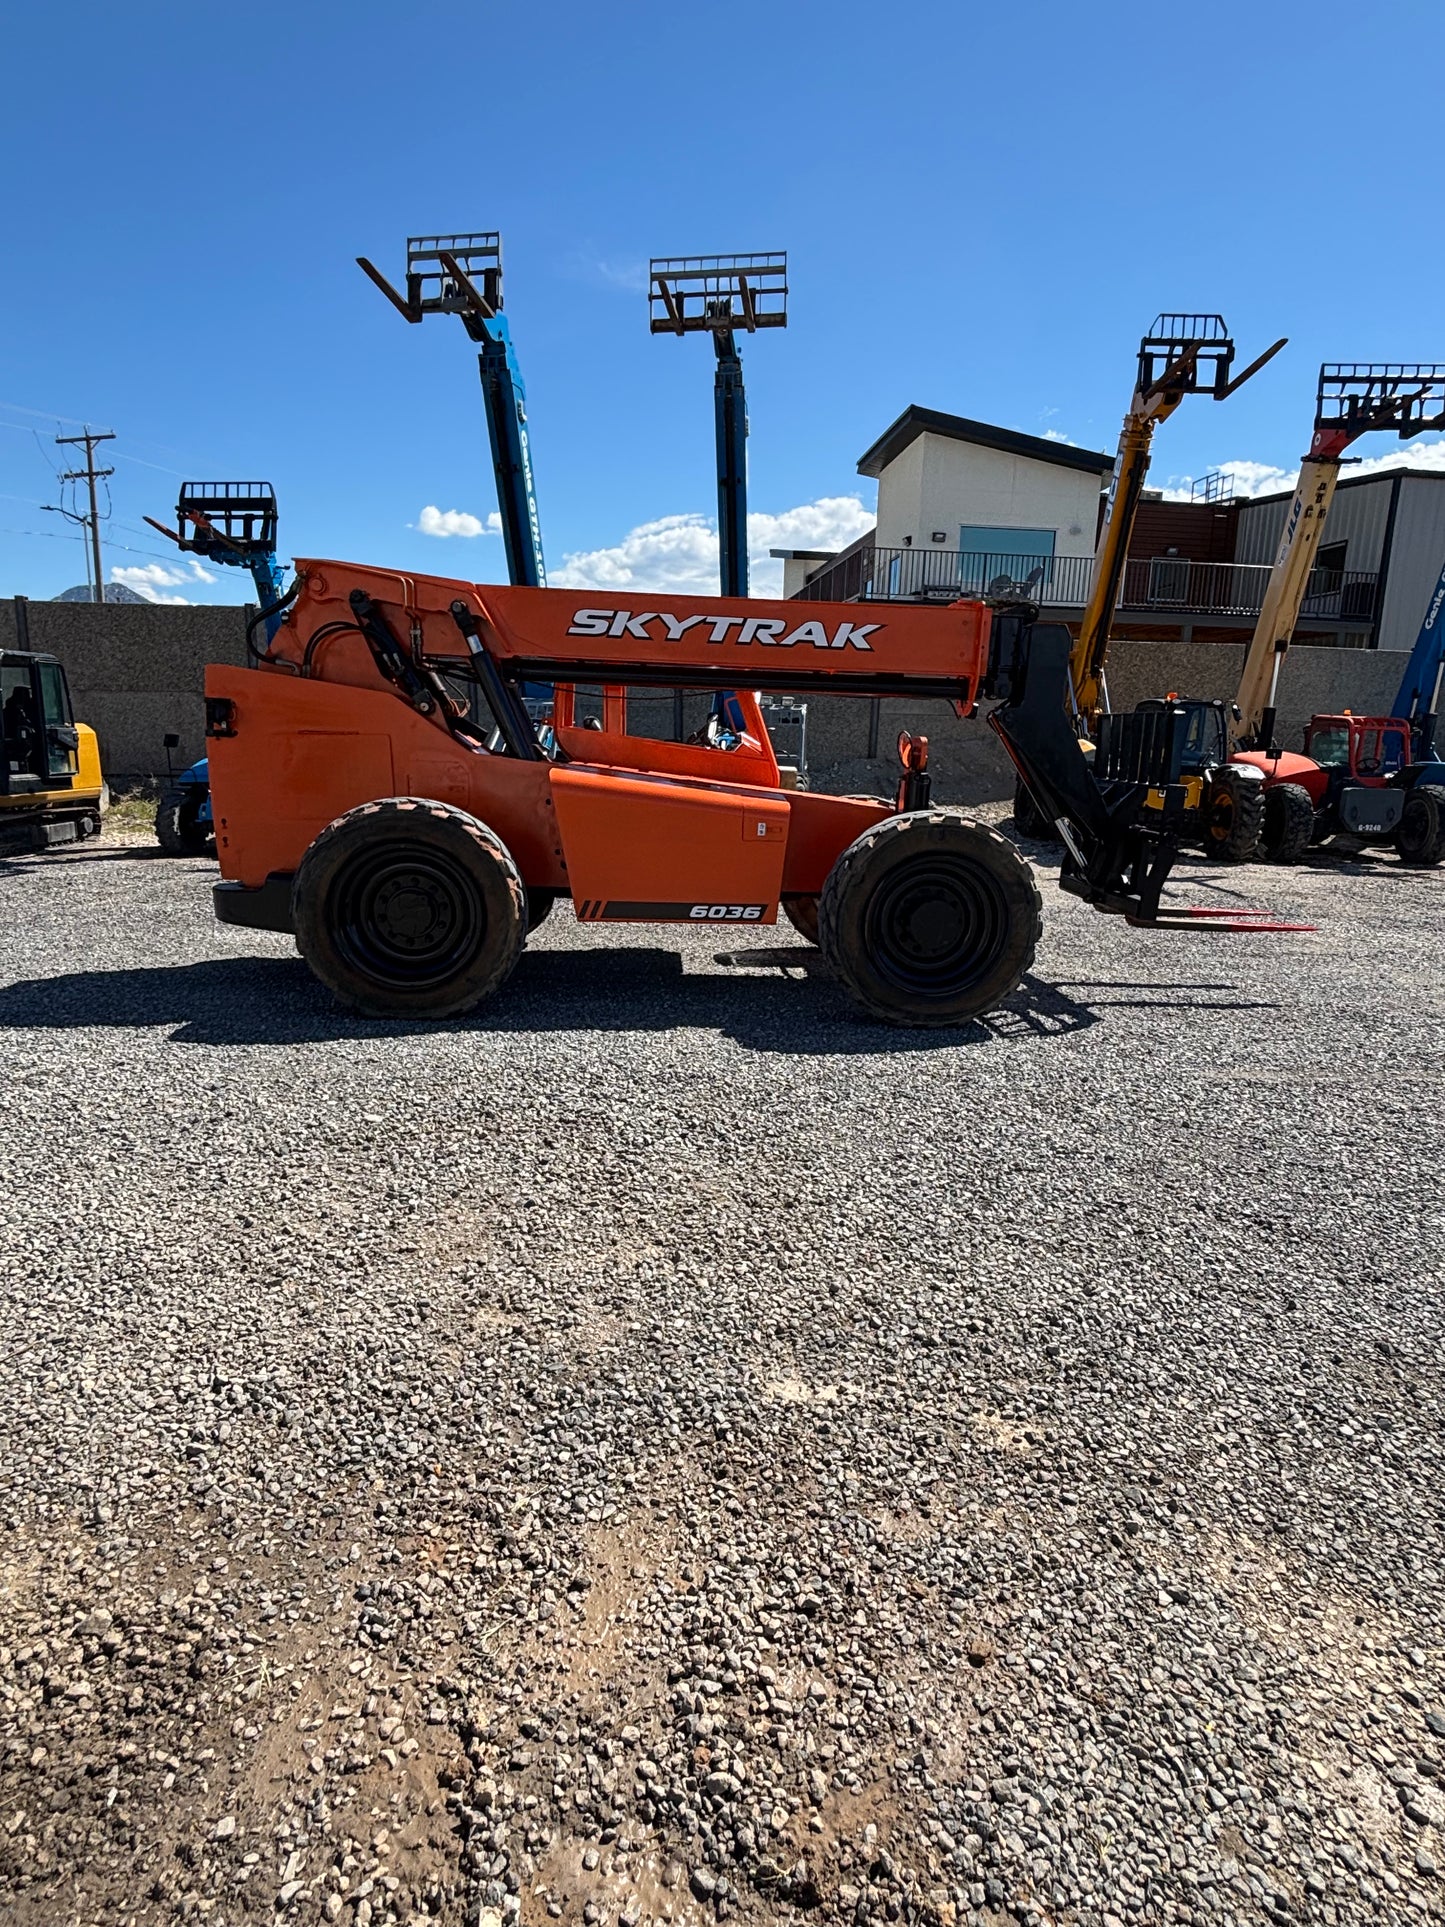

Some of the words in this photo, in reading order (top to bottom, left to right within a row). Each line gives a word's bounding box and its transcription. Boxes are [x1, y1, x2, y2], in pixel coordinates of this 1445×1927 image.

[520, 430, 532, 493] Genie
[1105, 453, 1124, 524] JCB
[1287, 497, 1302, 544] JLG
[567, 608, 886, 651] SKYTRAK
[1425, 588, 1445, 630] Genie
[689, 905, 762, 919] 6036
